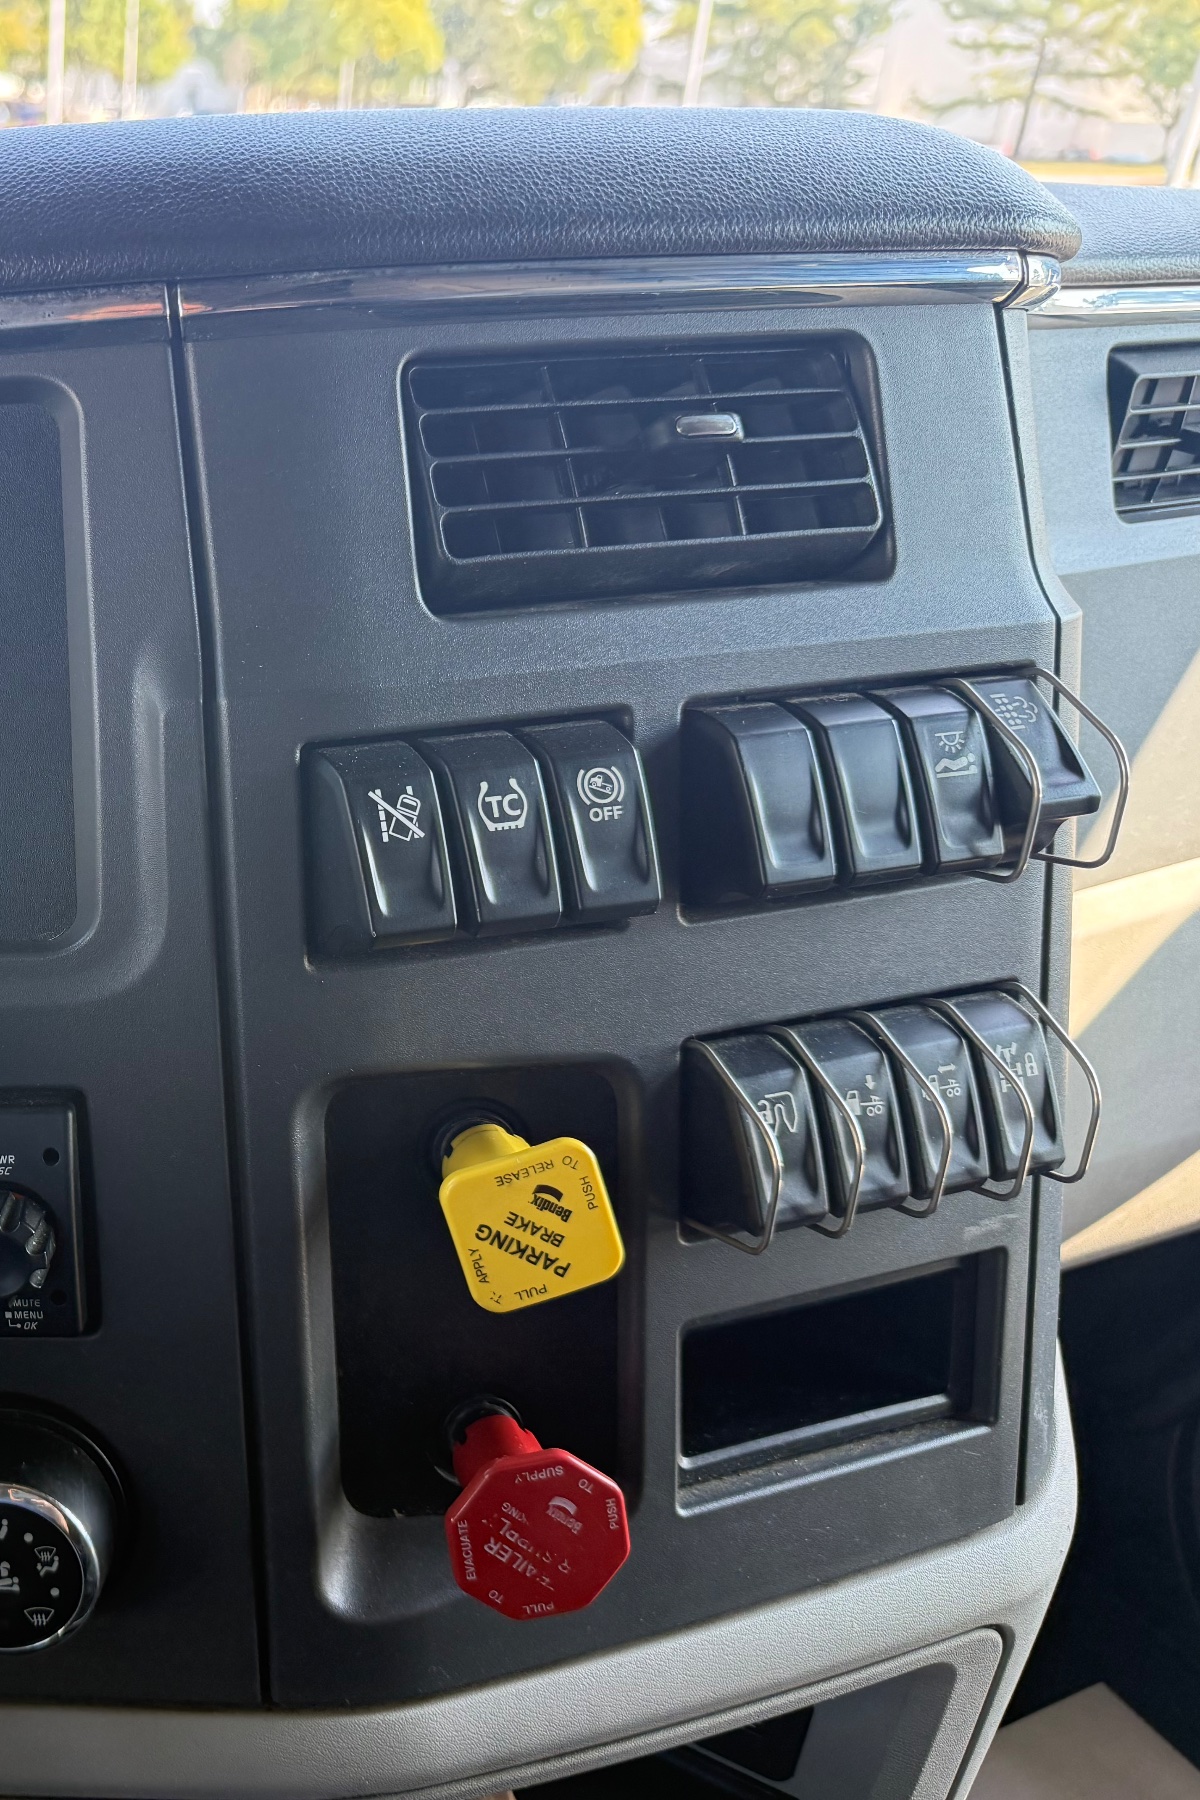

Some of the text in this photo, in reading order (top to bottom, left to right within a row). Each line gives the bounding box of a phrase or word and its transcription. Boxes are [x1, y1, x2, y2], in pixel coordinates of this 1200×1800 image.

[485, 794, 522, 817] TC
[588, 805, 623, 822] OFF
[494, 1155, 599, 1210] PUSH TO RELEASE
[528, 1193, 573, 1223] Bendix
[504, 1211, 565, 1248] BRAKE
[474, 1223, 572, 1278] PARKING
[468, 1248, 490, 1284] APPLY
[12, 1299, 41, 1307] MUTE
[514, 1283, 547, 1301] PULL
[14, 1311, 44, 1319] MENU
[23, 1321, 38, 1330] OK
[514, 1465, 620, 1530] PUSH TO SUPPLY
[457, 1520, 555, 1615] PULL TO EVACUATE
